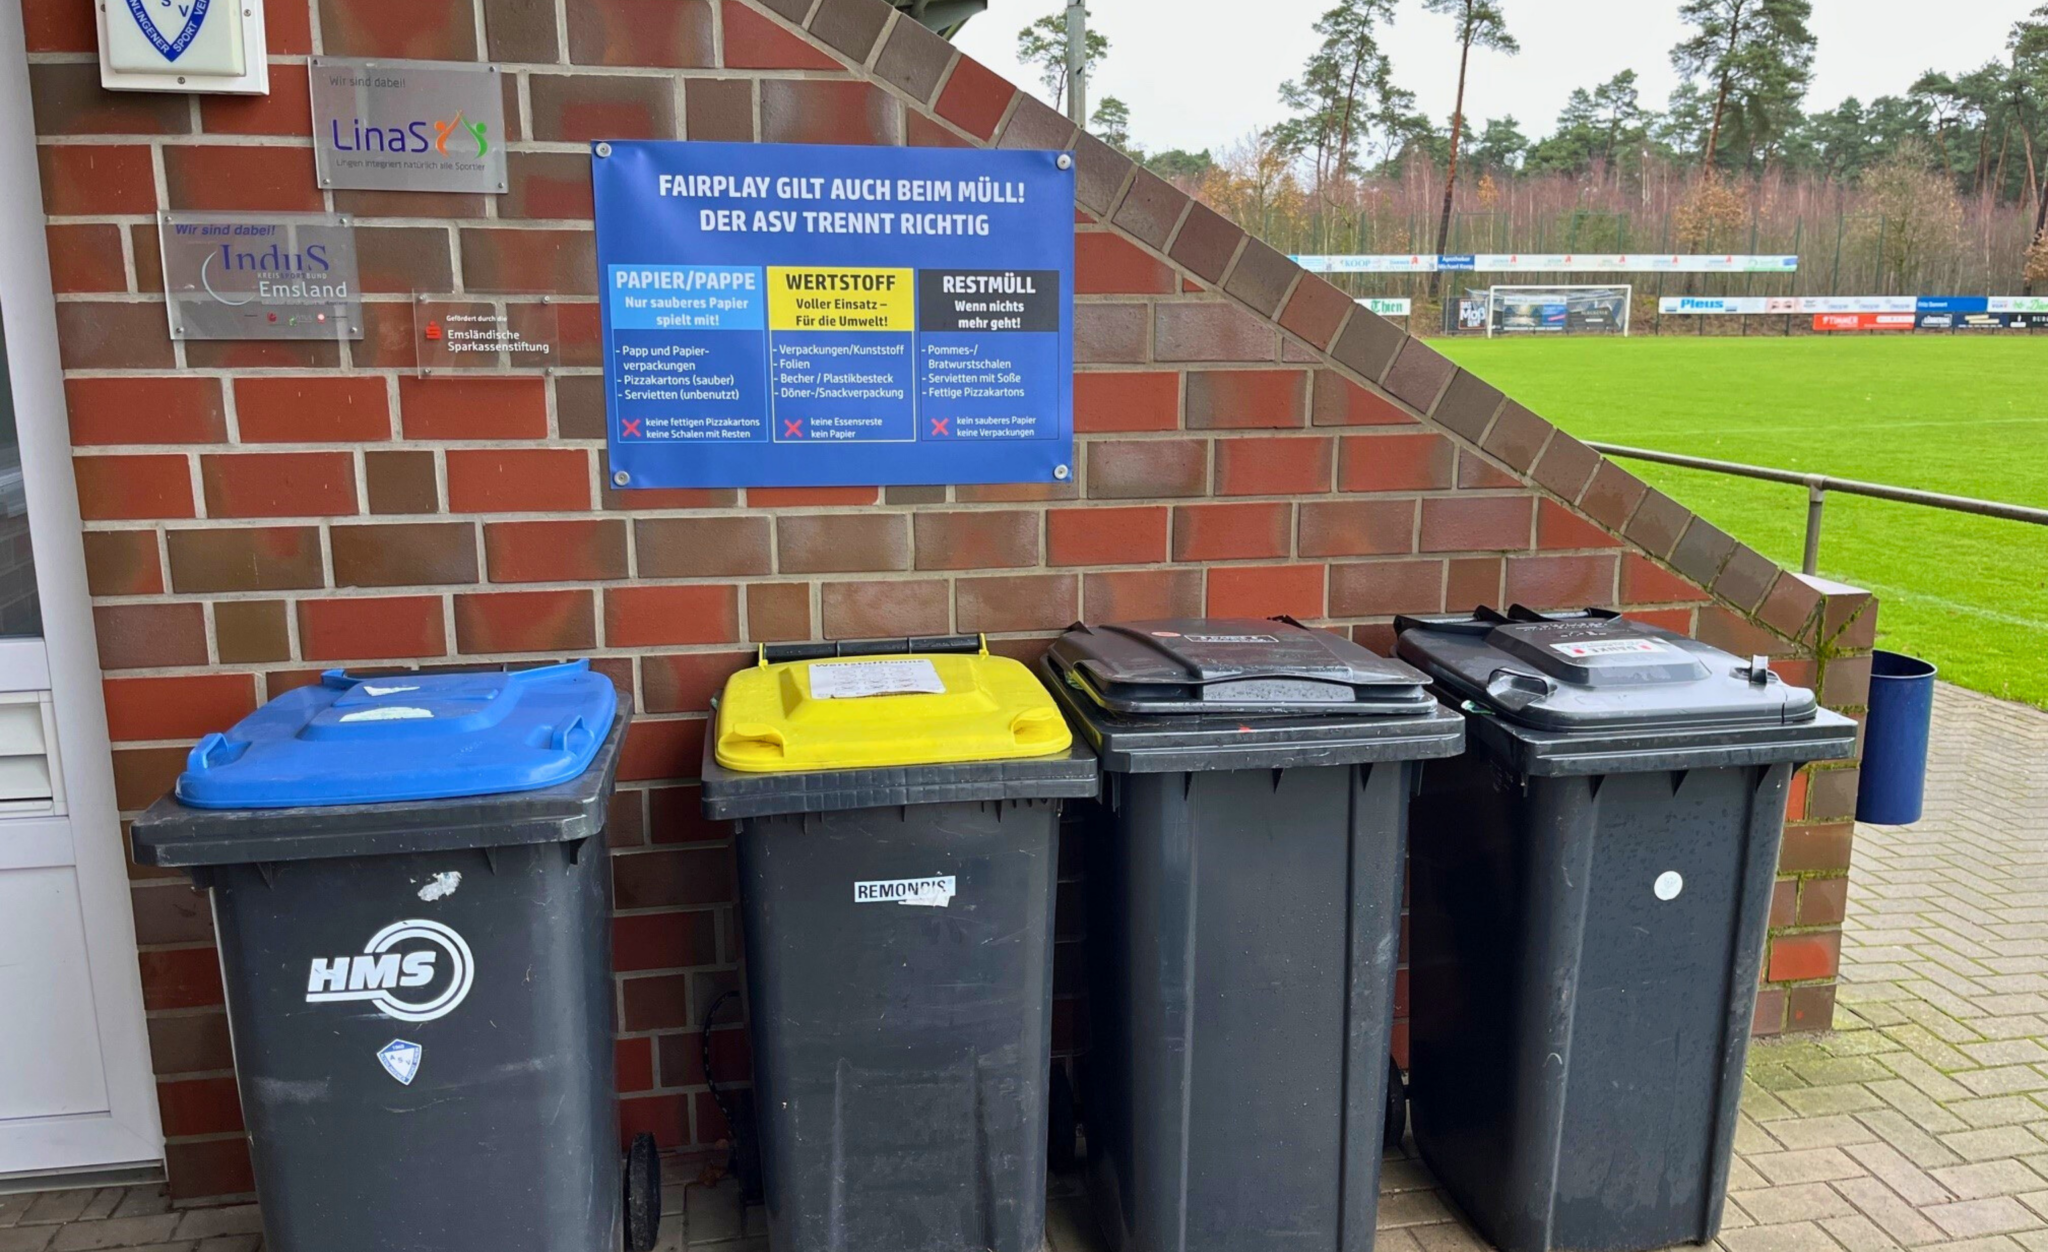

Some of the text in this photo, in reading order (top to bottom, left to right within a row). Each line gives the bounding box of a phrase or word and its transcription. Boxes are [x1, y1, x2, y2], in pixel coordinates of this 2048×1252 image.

[178, 5, 189, 17] V
[172, 21, 198, 52] SPORT
[329, 76, 406, 88] Wir sind dabei!
[332, 118, 429, 153] LinaS
[336, 160, 364, 171] Lingen
[404, 161, 438, 170] natürlich
[440, 161, 453, 170] alle
[455, 161, 486, 173] Sportler
[659, 174, 1025, 204] FAIRPLAY GILT AUCH BEIM MÜLL!
[700, 209, 990, 236] DER ASV TRENNT RICHTIG
[175, 224, 276, 236] Wir sind dabei!
[615, 270, 756, 291] PAPIER/PAPPE
[785, 273, 896, 291] WERTSTOFF
[942, 272, 1036, 294] RESTMÜLL
[259, 281, 348, 298] Emsland
[625, 296, 749, 311] Nur sauberes Papier
[796, 298, 832, 310] Voller
[834, 299, 878, 310] Einsatz
[954, 300, 1025, 312] Wenn nichts
[1370, 299, 1403, 313] Thien
[1680, 299, 1724, 309] Pleus
[656, 314, 720, 327] spielt mit!
[796, 315, 889, 327] Für die Umwelt!
[958, 317, 1021, 331] mehr geht!
[447, 329, 520, 340] Emsländische
[447, 341, 550, 354] Sparkassenstiftung
[622, 345, 710, 358] Papp und Papier-
[779, 344, 905, 357] Verpackungen/Kunststoff
[928, 344, 979, 356] Pommes-/
[623, 360, 696, 372] verpackungen
[780, 359, 811, 369] Folien
[928, 359, 1012, 369] Bratwurstschalen
[624, 374, 735, 386] Pizzakartons (sauber)
[780, 373, 815, 383] Becher
[823, 373, 894, 384] Plastikbesteck
[928, 373, 1021, 383] Servietten mit Soße
[624, 389, 740, 401] Servietten (unbenutzt)
[781, 387, 904, 400] Döner-/Snackverpackung
[928, 387, 1025, 399] Fettige Pizzakartons
[645, 418, 761, 429] keine fettigen Pizzakartons
[810, 418, 883, 426] keine Essensreste
[956, 416, 1037, 426] kein sauberes Papier
[646, 430, 751, 439] keine Schalen mit Resten
[811, 430, 856, 440] kein Papier
[957, 428, 1035, 438] keine Verpackungen
[307, 951, 437, 992] HMS
